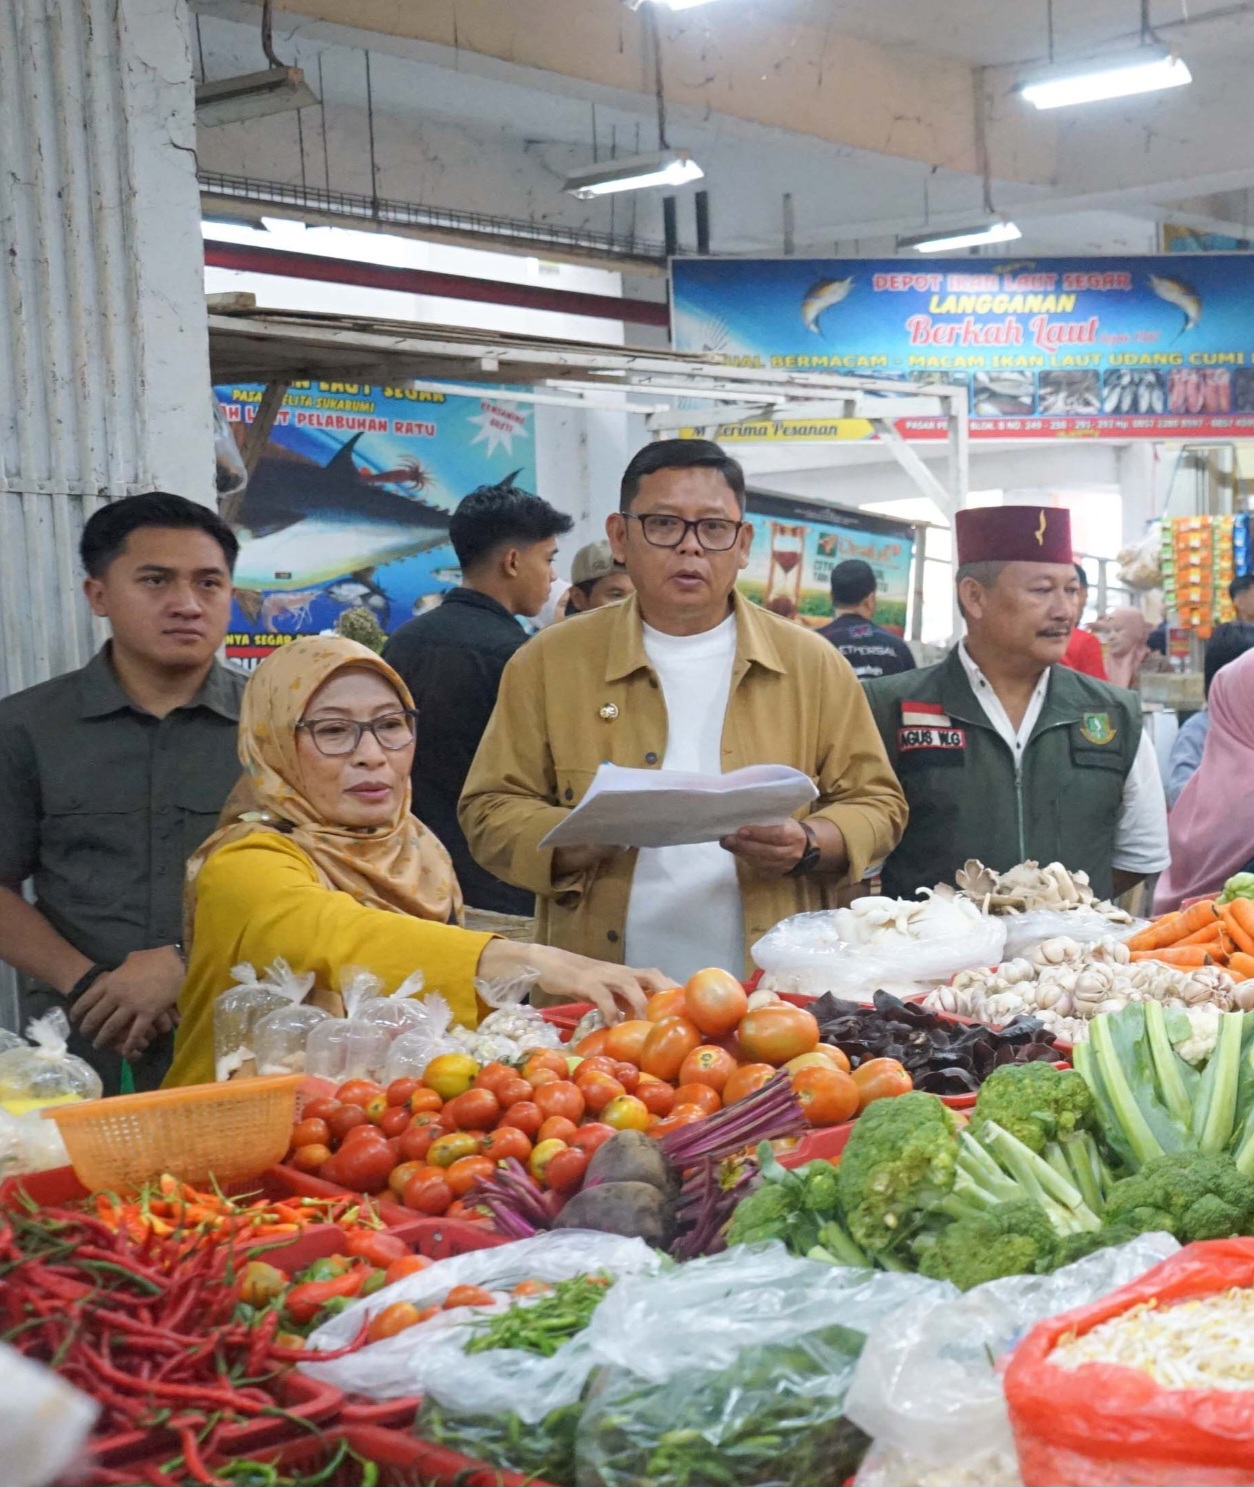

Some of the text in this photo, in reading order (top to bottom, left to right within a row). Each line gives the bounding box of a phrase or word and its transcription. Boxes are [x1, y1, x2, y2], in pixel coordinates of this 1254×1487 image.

[873, 273, 942, 291] DEPOT
[1062, 273, 1132, 291] SEGAR
[928, 293, 1077, 315] LANGGANAN
[906, 314, 1023, 346] Berkah
[1028, 315, 1100, 353] Laut
[771, 354, 887, 368] BERMACAM
[908, 353, 985, 368] MACAM
[992, 353, 1044, 368] IKAN
[1051, 352, 1102, 367] LAUT
[1109, 352, 1183, 366] UDANG
[1189, 351, 1245, 365] CUMI
[232, 389, 263, 403] PASA
[296, 411, 388, 433] PELABUHAN
[394, 421, 436, 438] RATU
[771, 421, 838, 437] Pesanan
